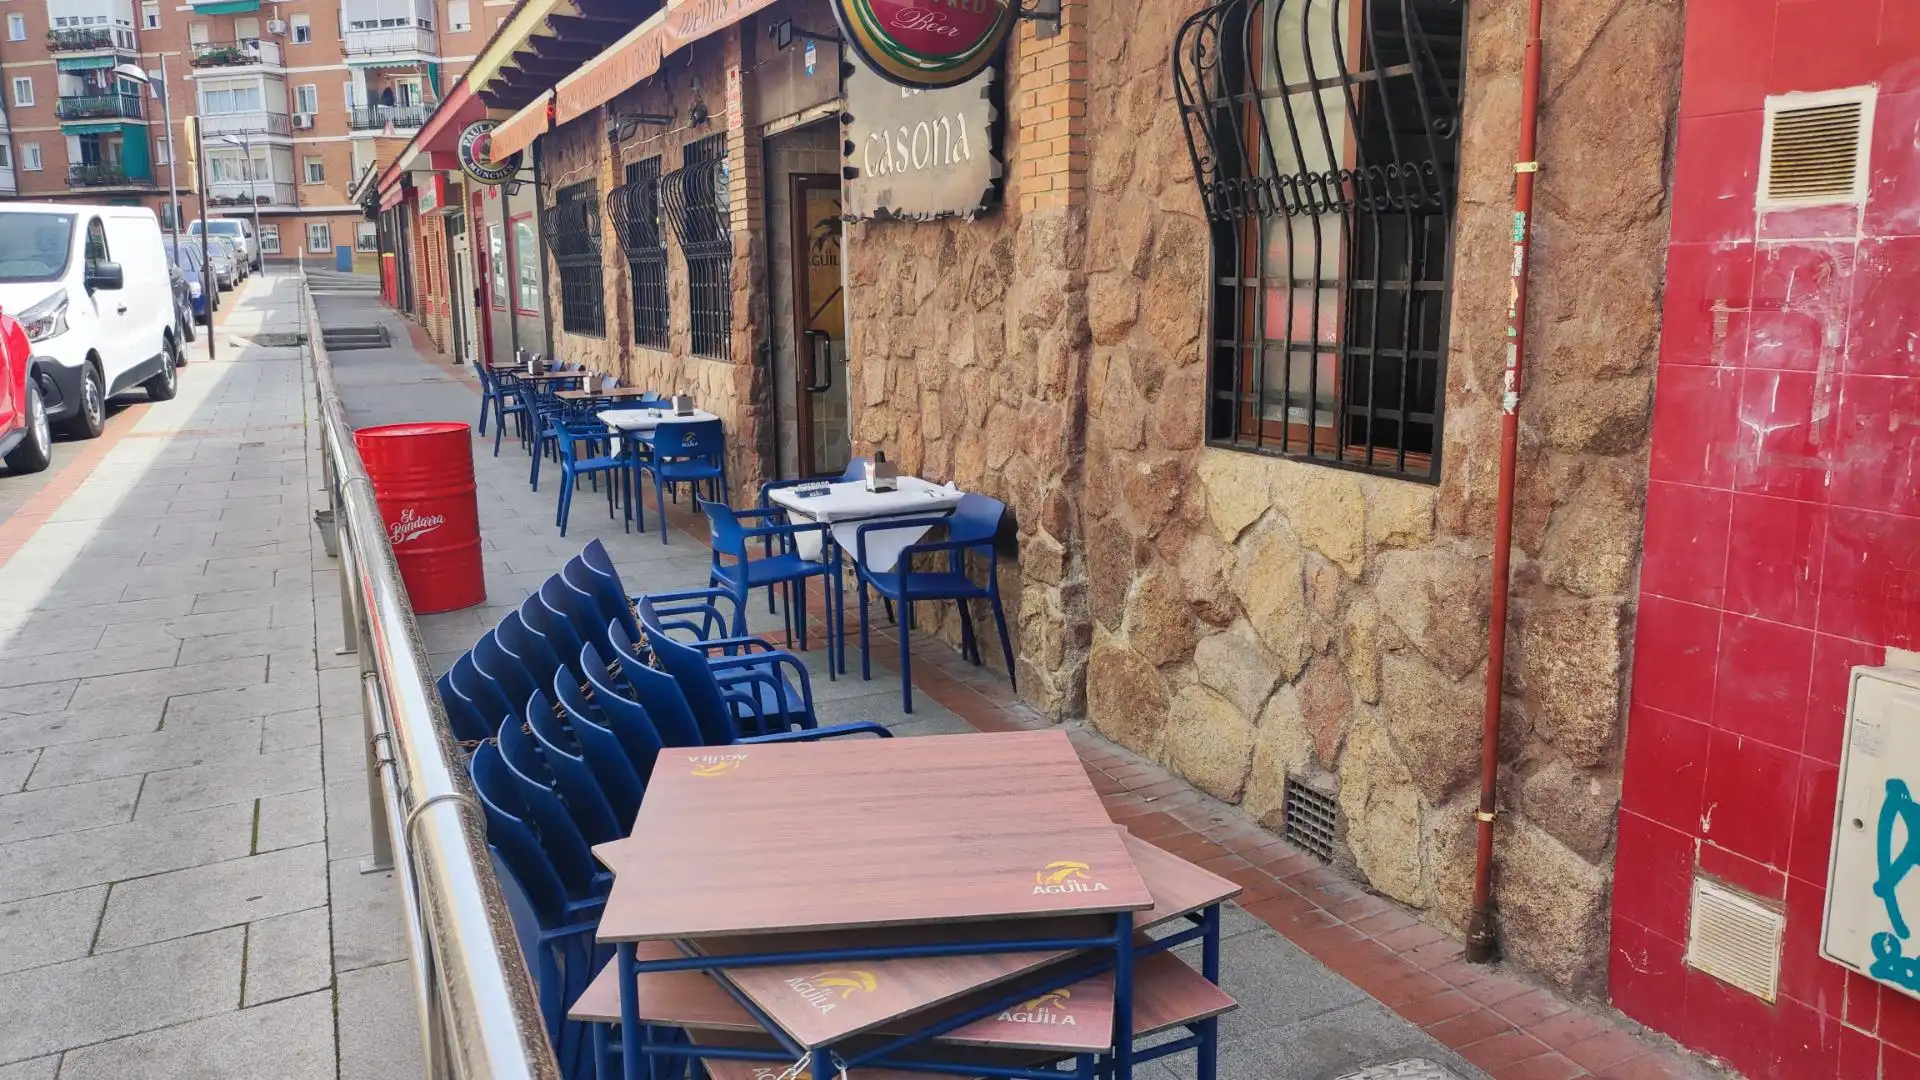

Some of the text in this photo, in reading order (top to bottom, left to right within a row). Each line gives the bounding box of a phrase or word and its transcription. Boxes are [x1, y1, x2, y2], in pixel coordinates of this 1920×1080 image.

[890, 7, 960, 37] Beer
[390, 515, 446, 545] Bandarra
[401, 508, 415, 523] El
